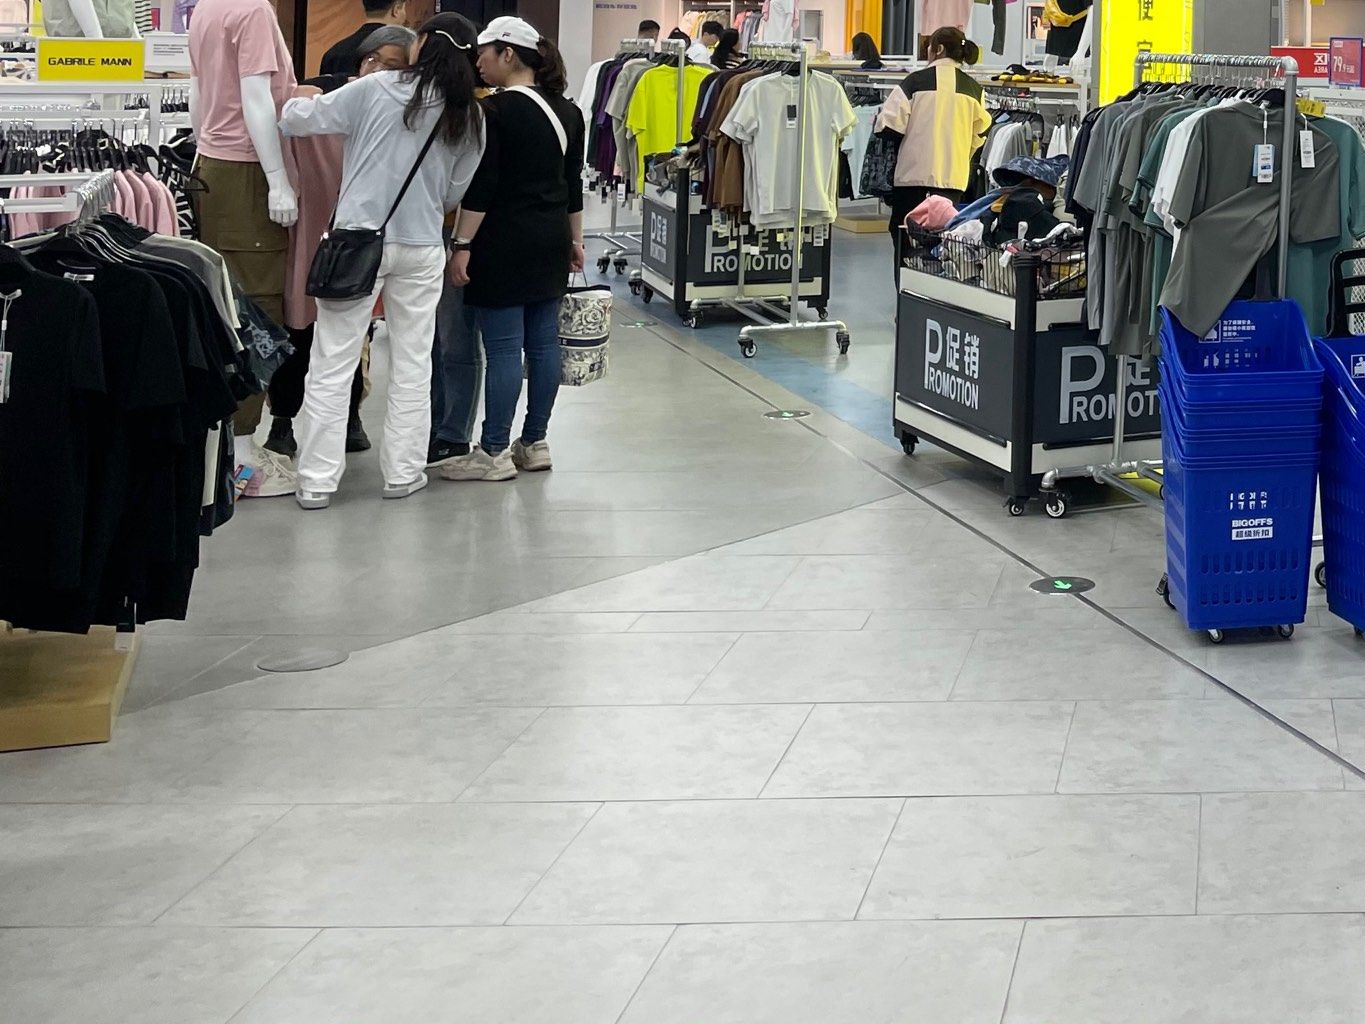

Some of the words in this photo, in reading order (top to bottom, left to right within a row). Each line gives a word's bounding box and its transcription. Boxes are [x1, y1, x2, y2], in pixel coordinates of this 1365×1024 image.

[48, 57, 96, 66] GABRILE
[101, 57, 132, 67] MANN
[946, 325, 980, 379] 促销
[1232, 518, 1273, 527] BIGOFFS
